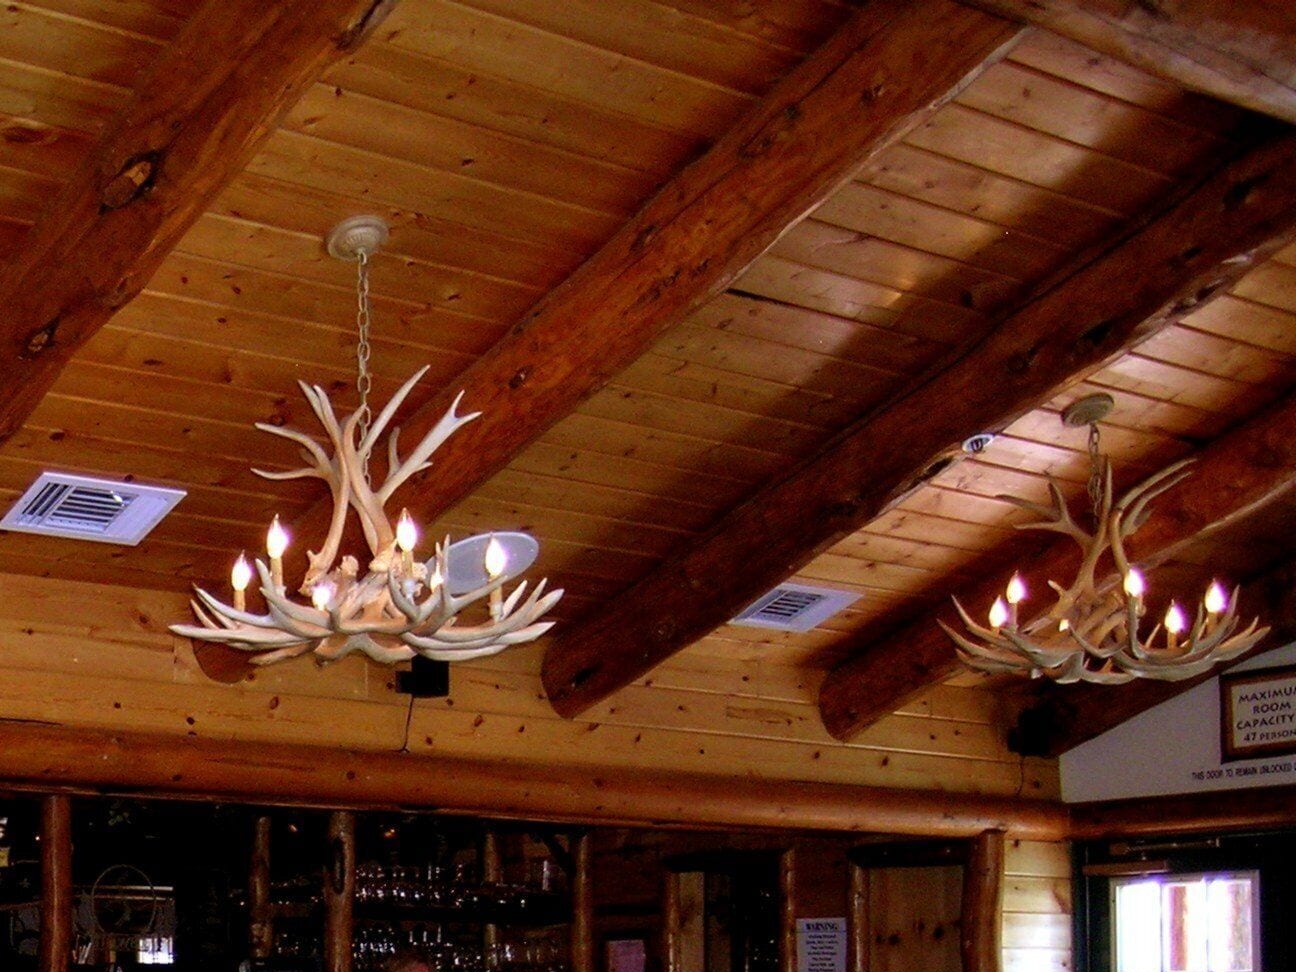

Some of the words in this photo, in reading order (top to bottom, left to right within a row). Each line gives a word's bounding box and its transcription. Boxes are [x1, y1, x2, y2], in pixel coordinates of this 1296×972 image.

[1252, 702, 1291, 714] ROOM
[1236, 714, 1295, 730] CAPACITY
[1244, 731, 1257, 742] 47
[806, 922, 840, 931] WARNING
